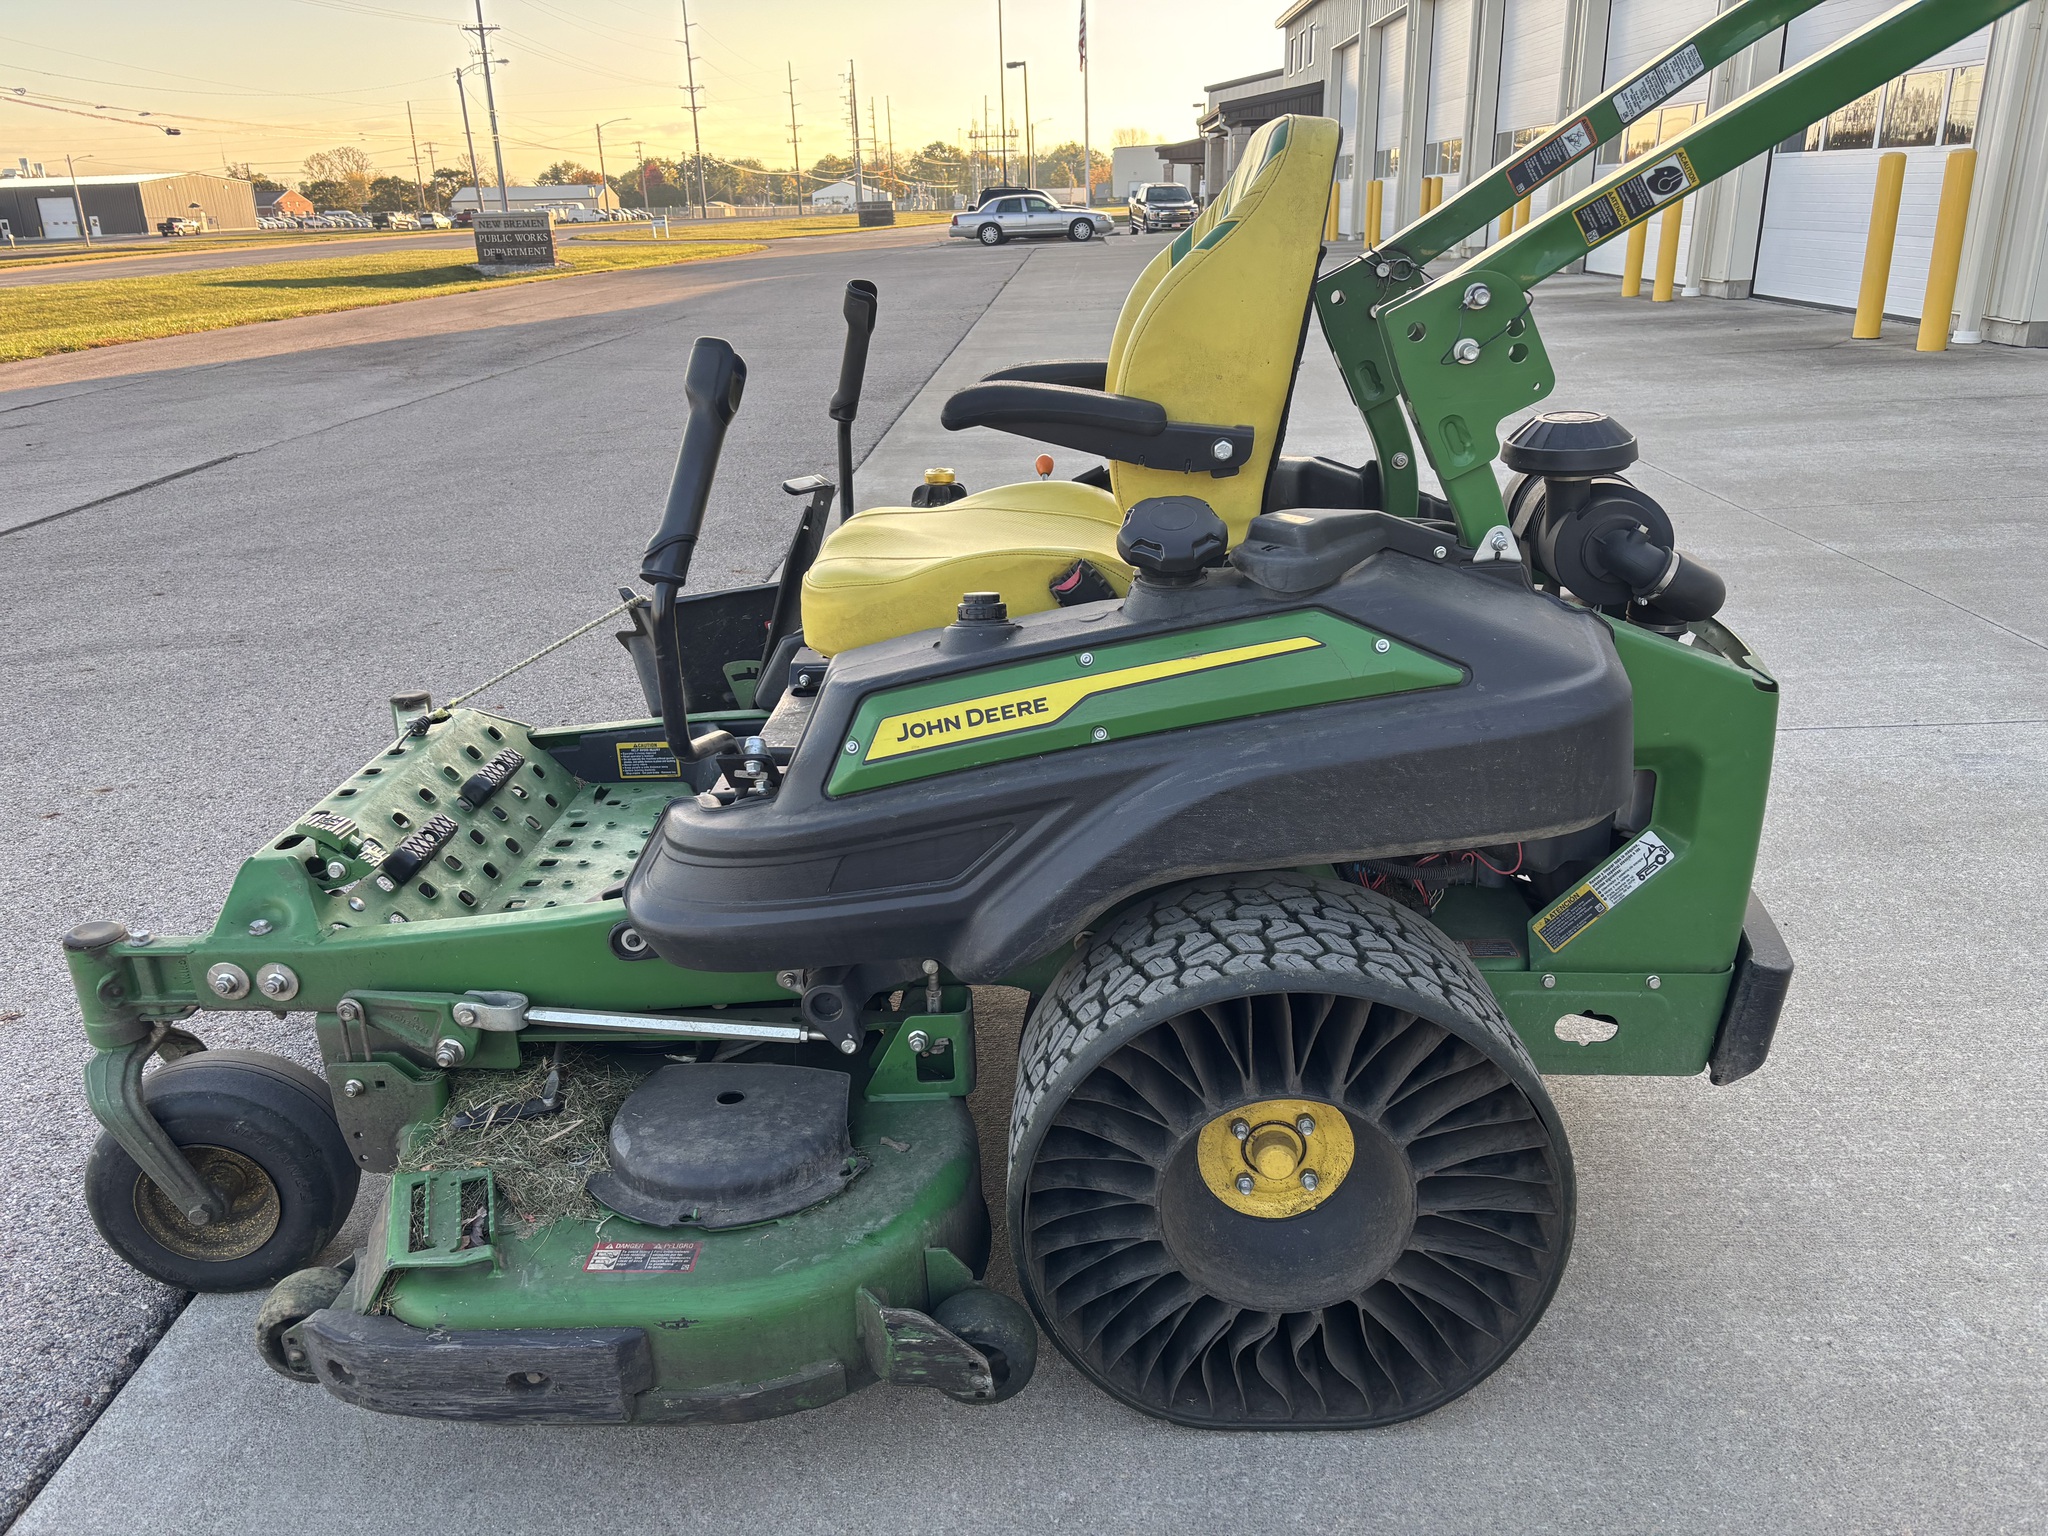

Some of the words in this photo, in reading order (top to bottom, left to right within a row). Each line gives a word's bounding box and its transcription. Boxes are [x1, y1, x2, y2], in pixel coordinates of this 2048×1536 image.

[1681, 156, 1696, 183] CAUTION
[504, 220, 544, 228] BREMEN
[1610, 196, 1628, 225] ATENCIÓN
[479, 234, 512, 243] PUBLIC
[515, 233, 548, 242] WORKS
[484, 247, 547, 256] DEPARTMENT
[897, 715, 961, 742] JOHN
[966, 697, 1049, 727] DEERE
[1548, 892, 1580, 920] ATENCIÓN
